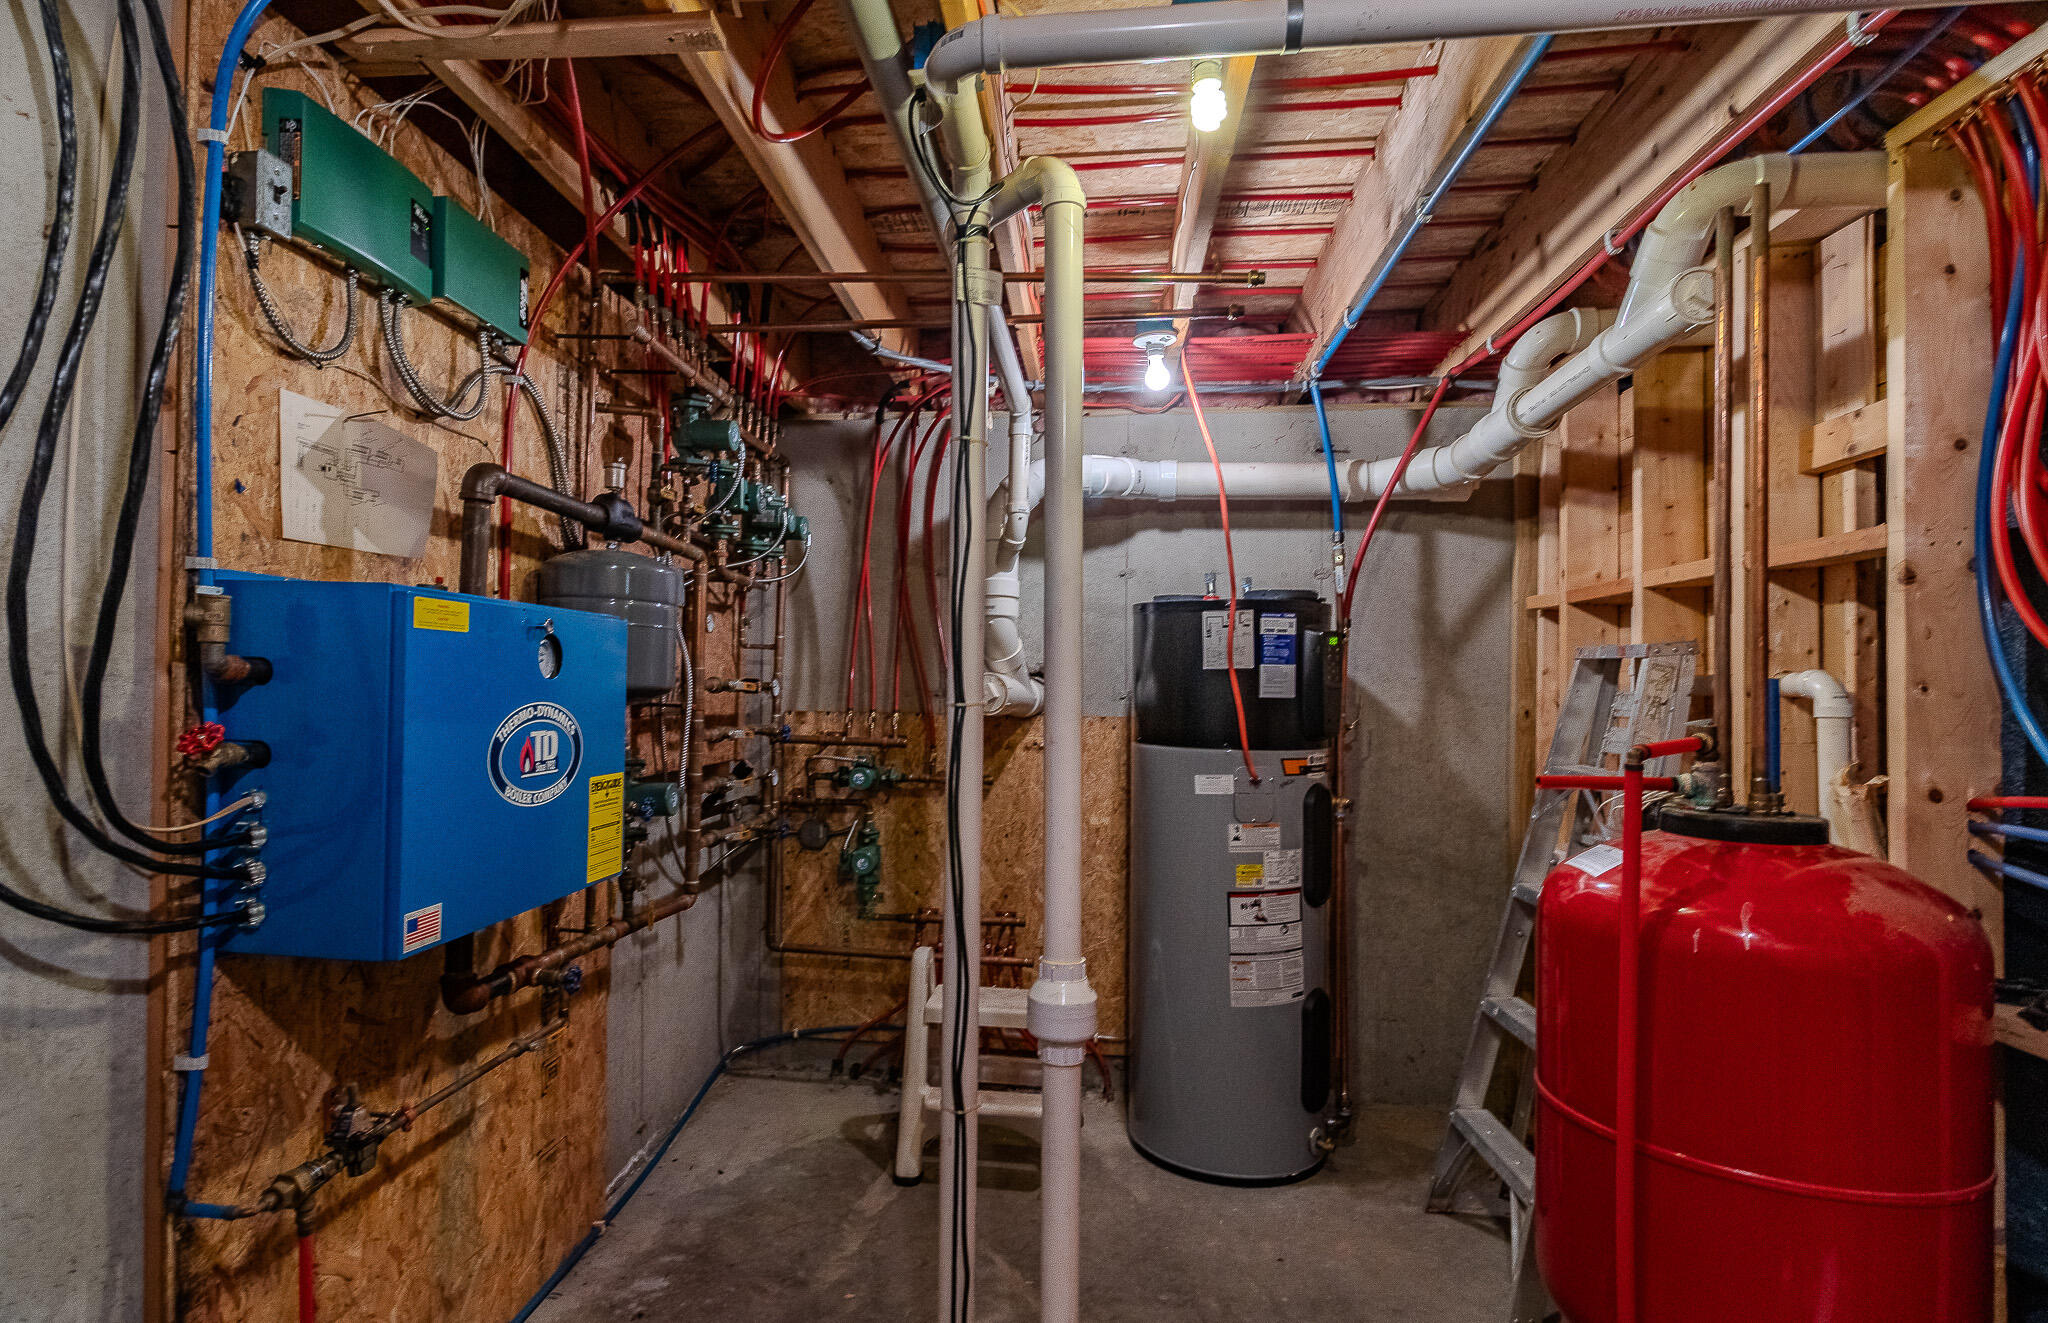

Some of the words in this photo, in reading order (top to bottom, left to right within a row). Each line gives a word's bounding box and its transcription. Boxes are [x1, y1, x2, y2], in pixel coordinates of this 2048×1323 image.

[496, 706, 577, 743] THERMO-DYNAMICS
[530, 729, 559, 762] TD
[504, 786, 533, 804] BOILER
[532, 776, 569, 804] COMPANY
